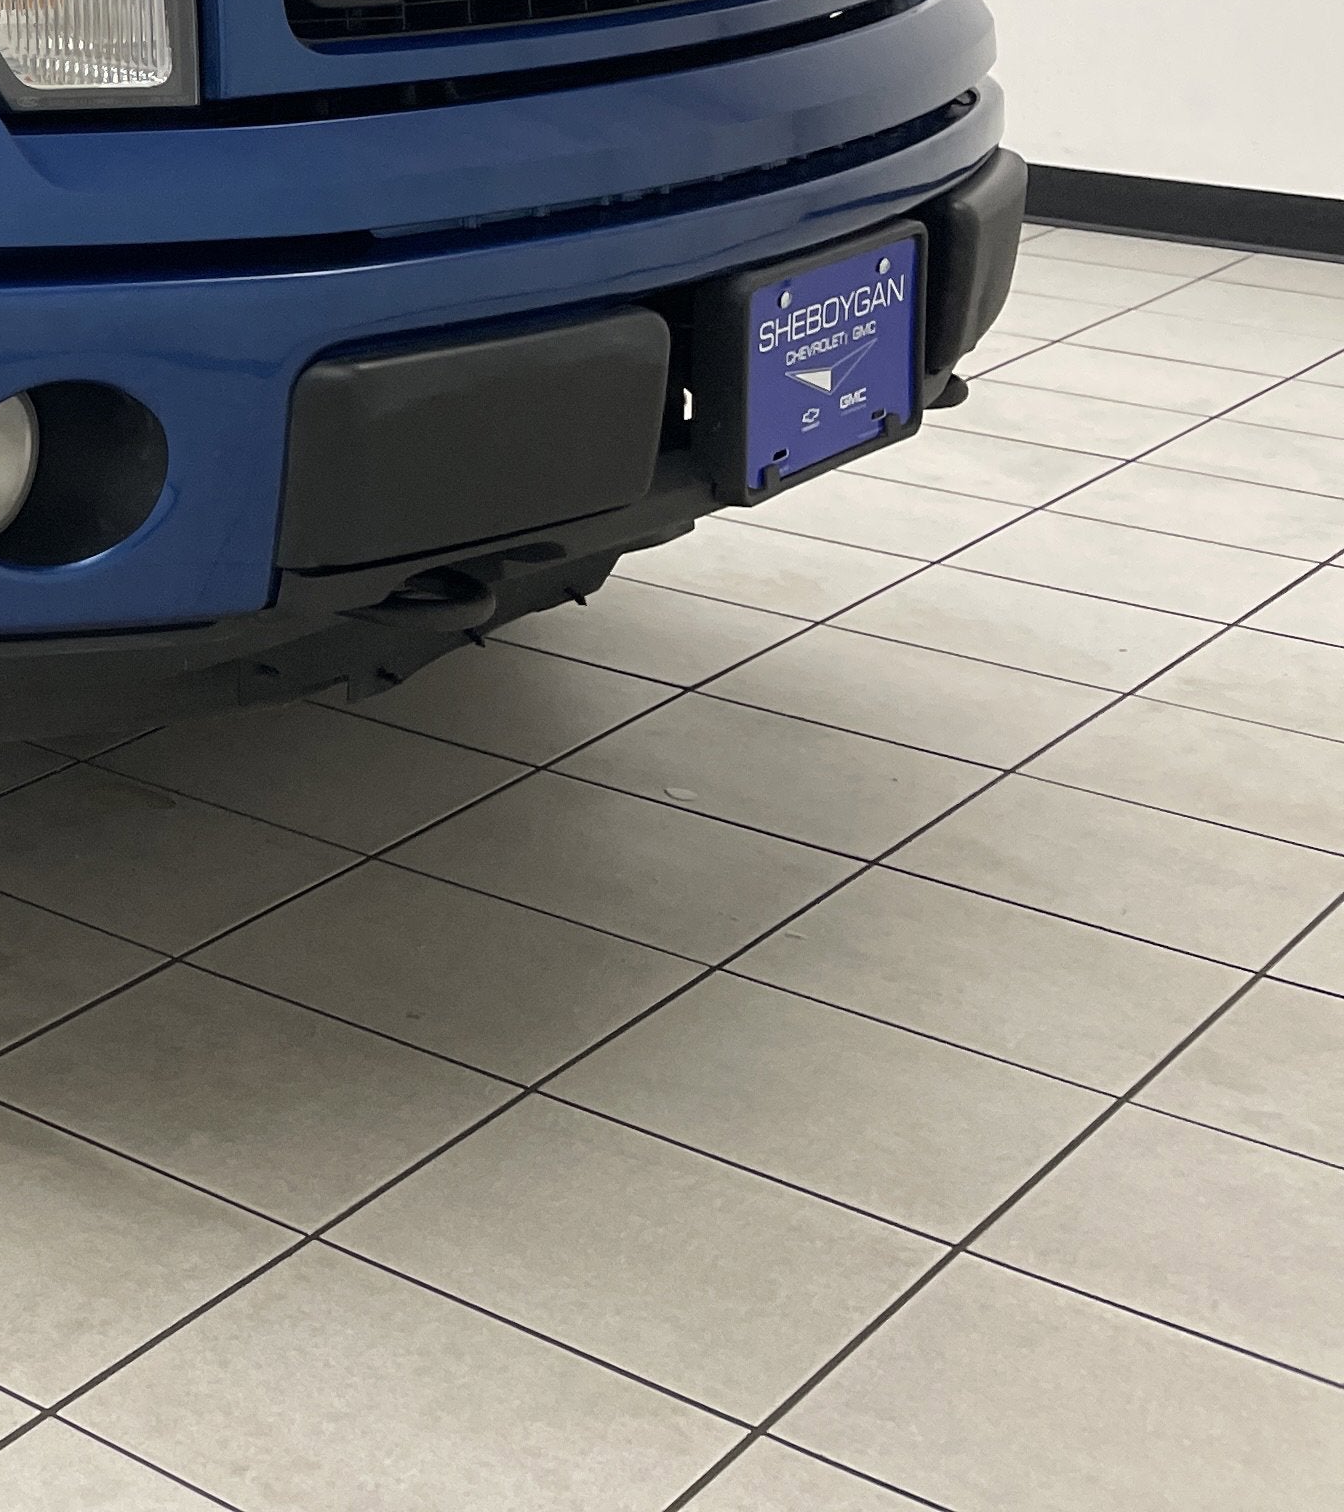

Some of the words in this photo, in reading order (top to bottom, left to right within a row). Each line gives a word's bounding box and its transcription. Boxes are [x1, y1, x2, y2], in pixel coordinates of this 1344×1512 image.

[758, 273, 905, 353] SHEBOYGAN
[852, 319, 877, 341] GMC
[839, 387, 867, 410] GMC
